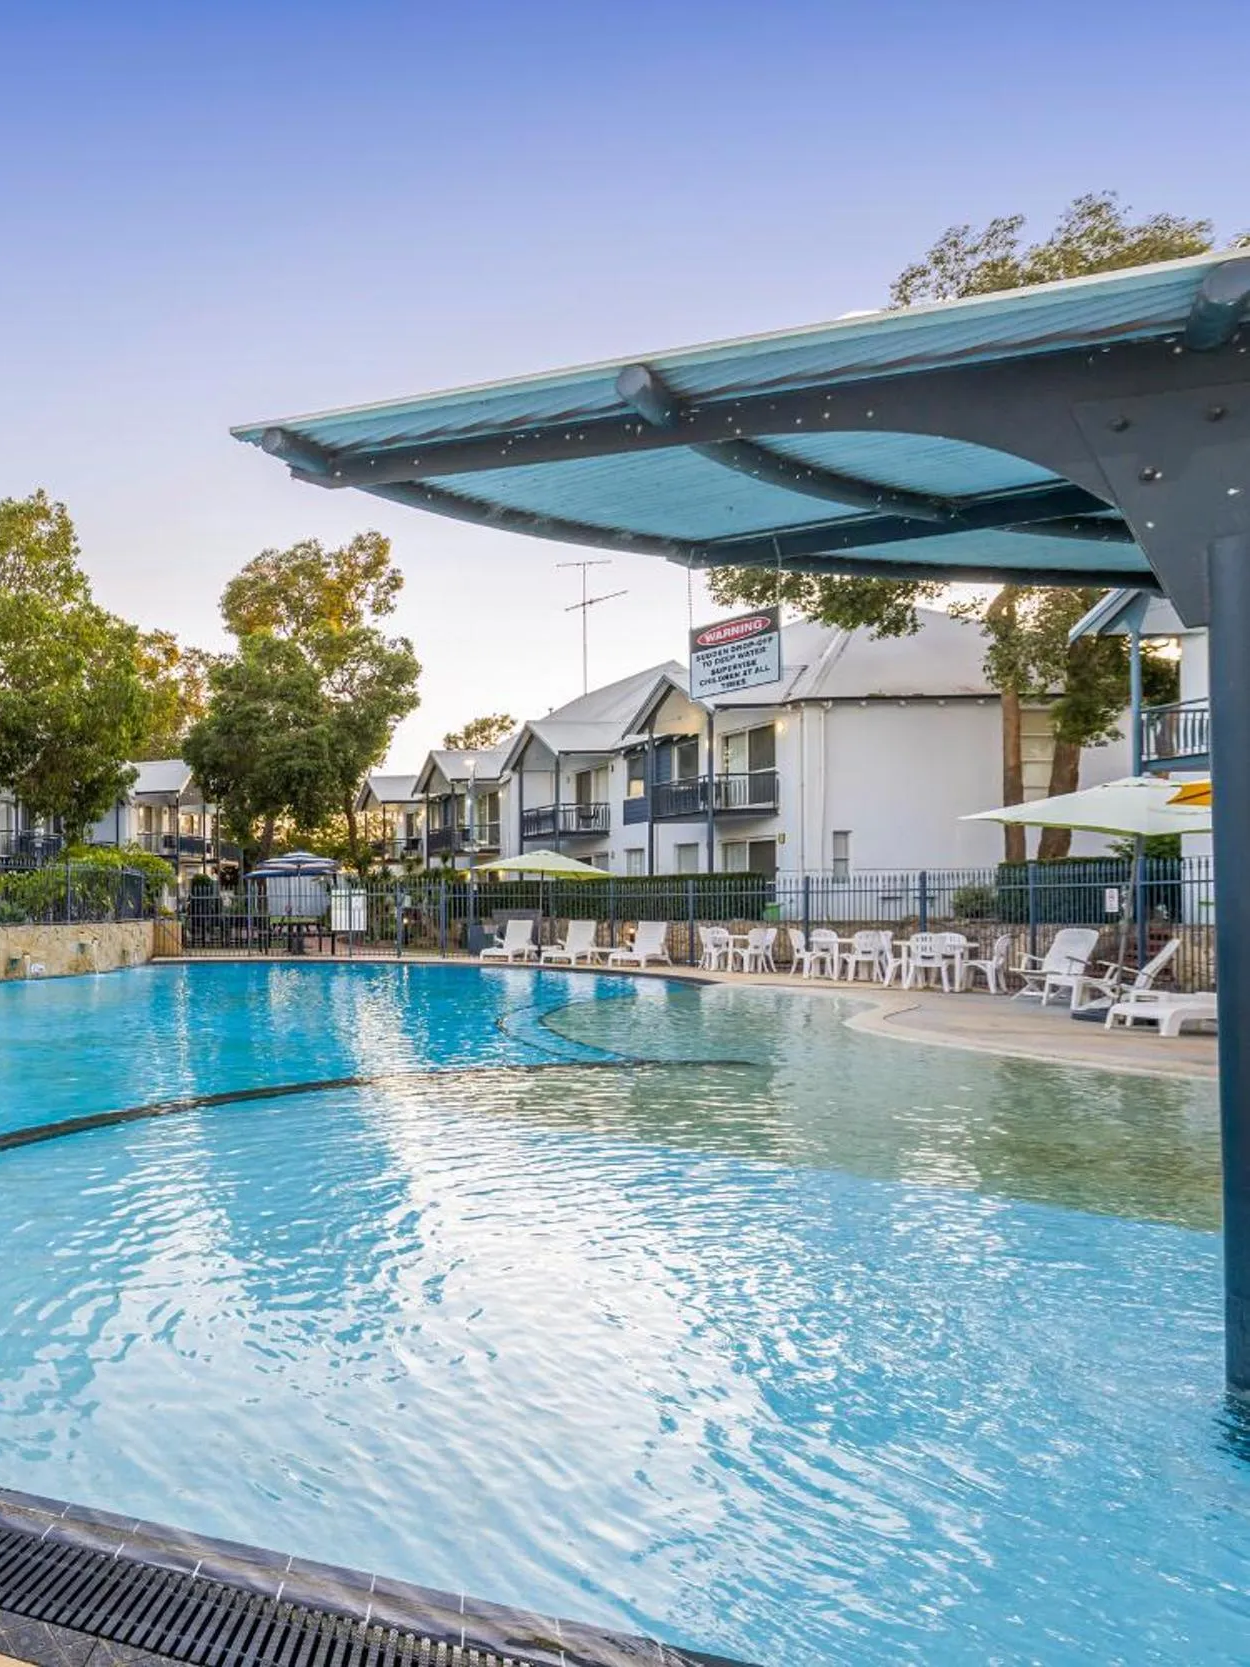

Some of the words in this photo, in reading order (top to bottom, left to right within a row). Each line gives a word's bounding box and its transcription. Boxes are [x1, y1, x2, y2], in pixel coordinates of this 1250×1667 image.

[704, 620, 763, 642] WARNING
[696, 648, 729, 662] SUDDEN
[702, 660, 713, 668] TO
[738, 646, 766, 659] WATER
[755, 665, 770, 674] ALL
